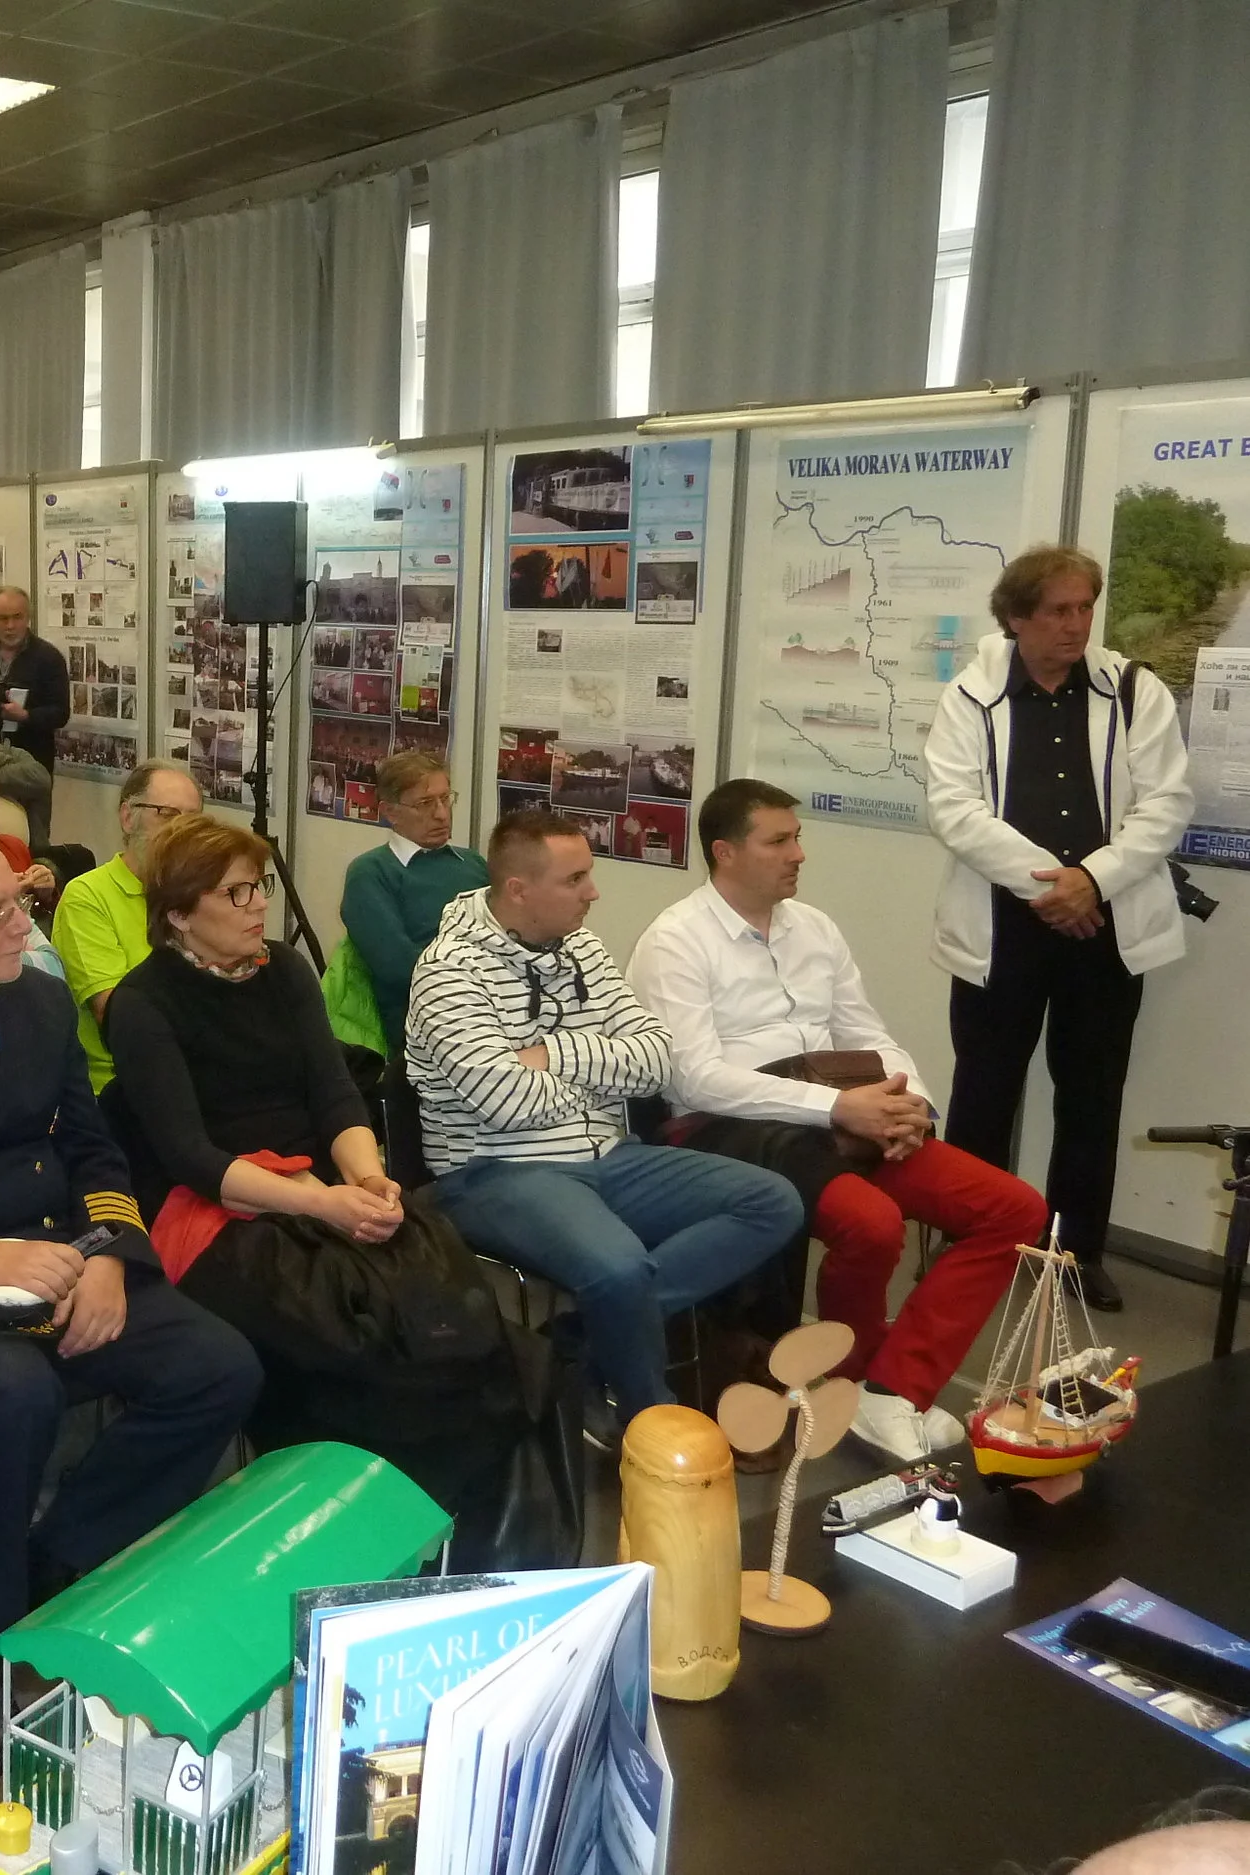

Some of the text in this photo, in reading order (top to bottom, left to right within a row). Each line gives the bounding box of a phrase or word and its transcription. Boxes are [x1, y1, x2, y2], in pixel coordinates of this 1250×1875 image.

[1154, 438, 1233, 461] GREAT
[788, 447, 1014, 478] VELIKA MORAVA WATERWAY
[873, 599, 892, 607] 1961
[843, 796, 919, 814] ENERGOPROJEKT
[376, 1613, 543, 1686] PEARL OF
